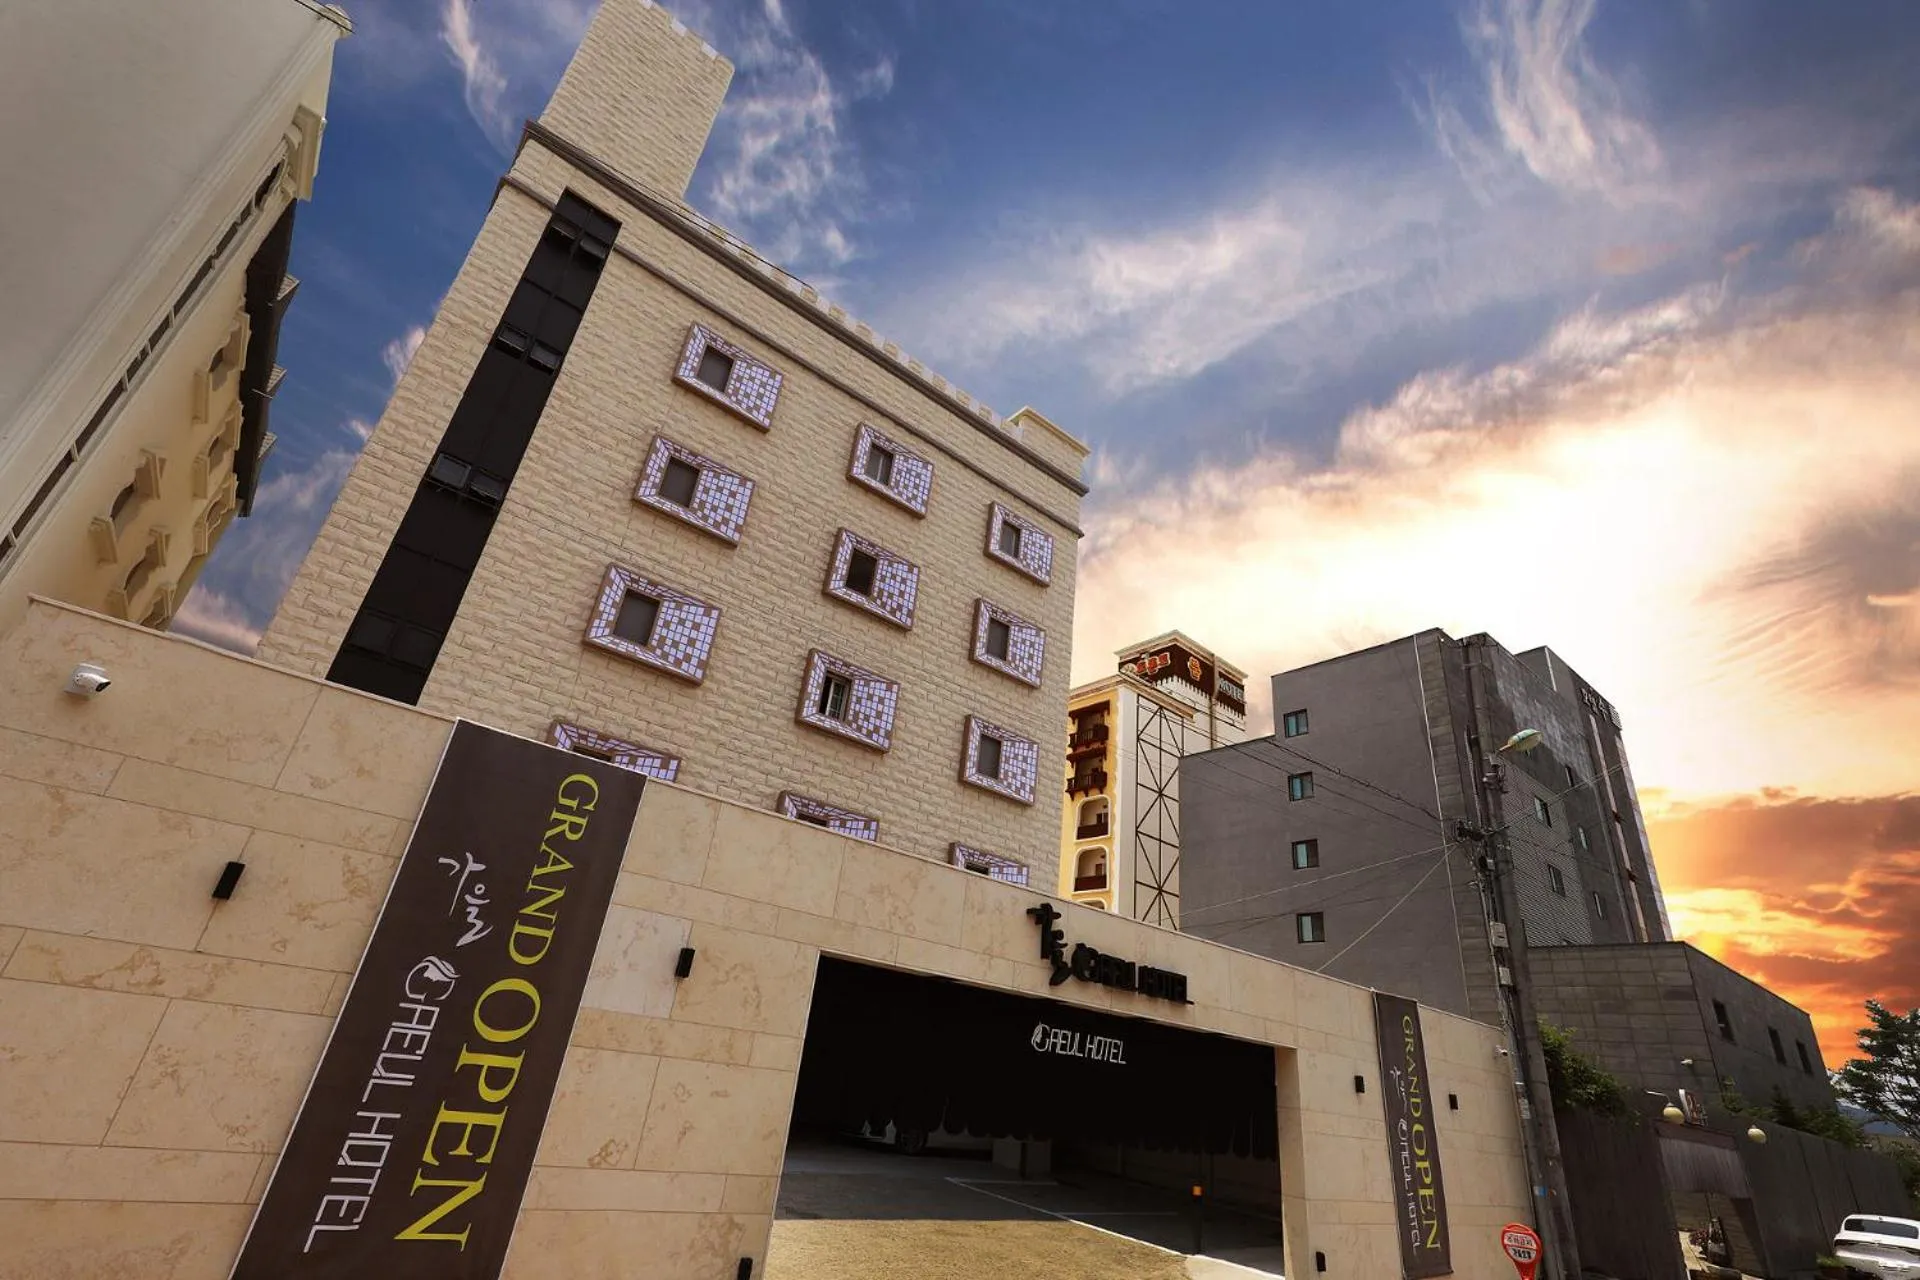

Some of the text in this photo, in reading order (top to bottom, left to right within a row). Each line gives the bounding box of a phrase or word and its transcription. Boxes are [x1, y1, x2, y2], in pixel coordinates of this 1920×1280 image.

[438, 852, 494, 947] 가을
[393, 773, 599, 1252] GRAND OPEN
[1085, 1033, 1127, 1064] HOTEL
[303, 1110, 402, 1254] HOTEL
[1402, 1014, 1442, 1252] GRAND OPEN
